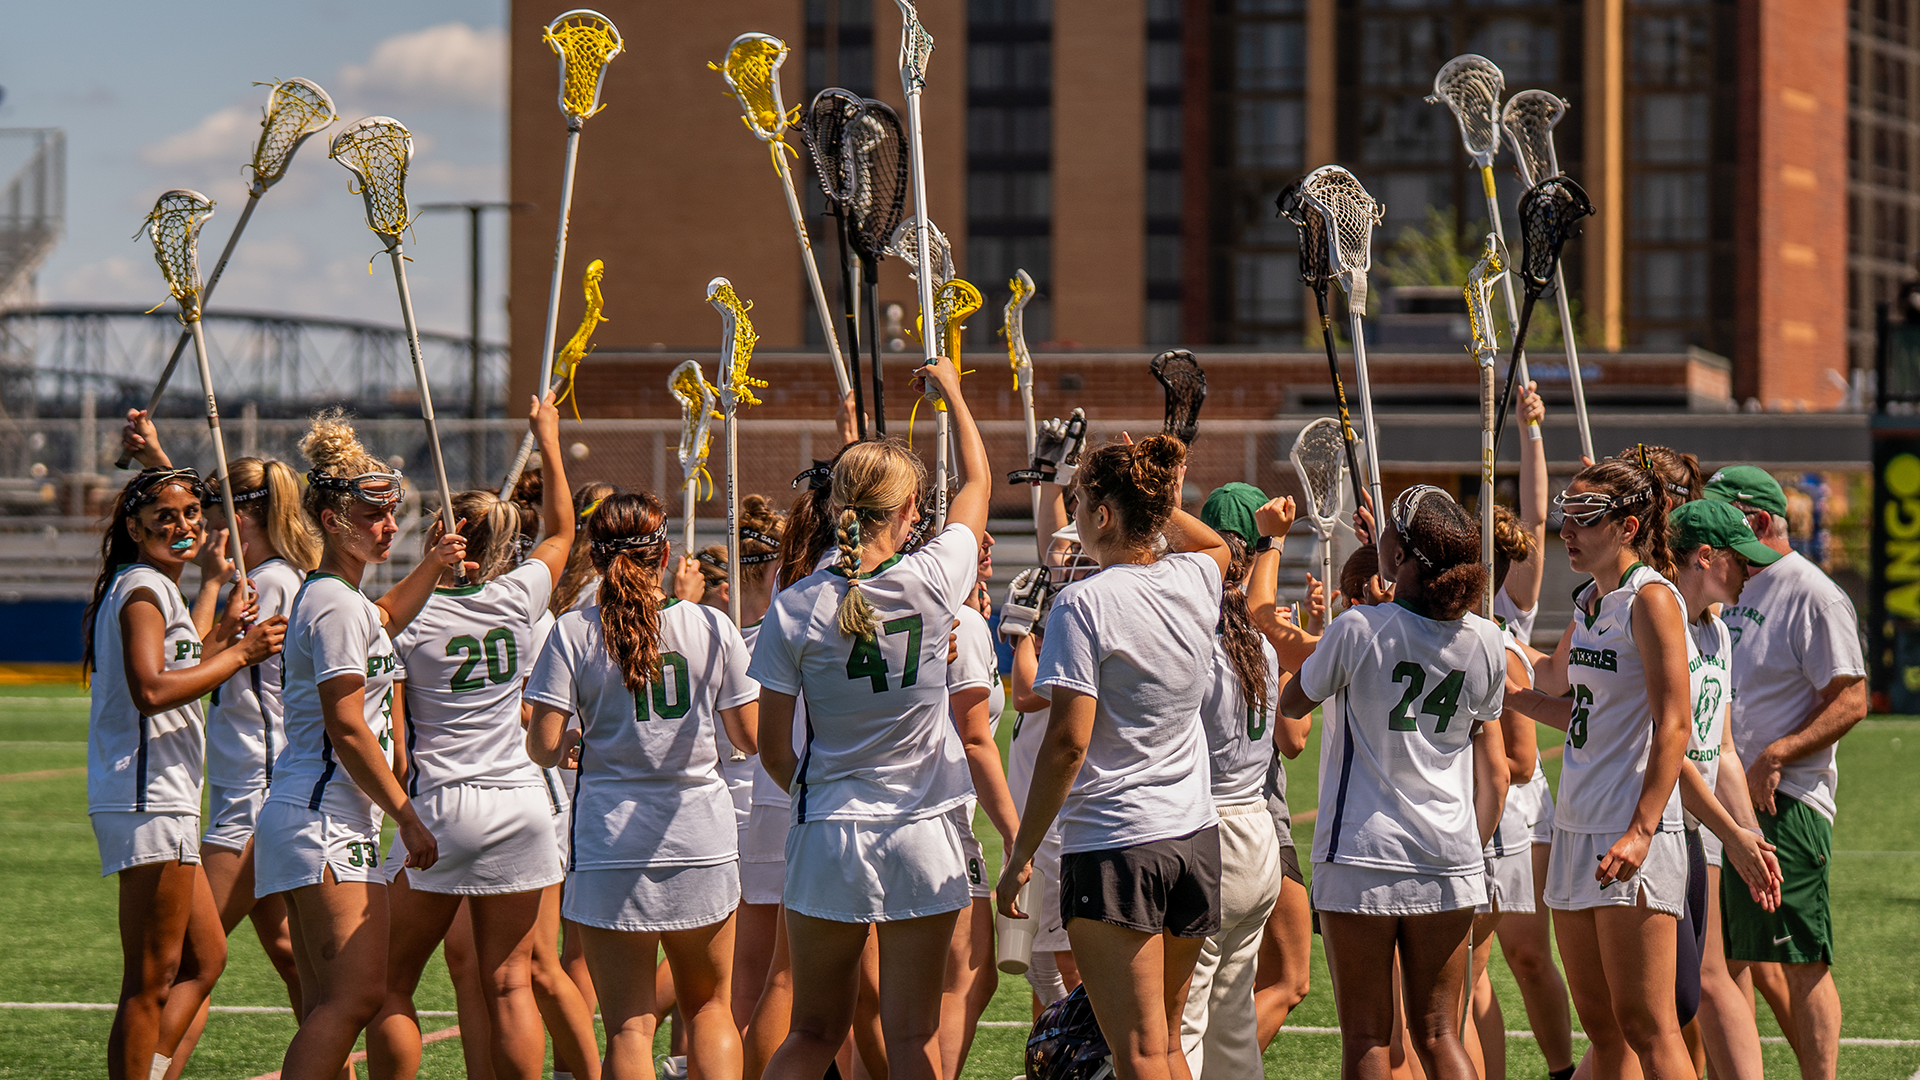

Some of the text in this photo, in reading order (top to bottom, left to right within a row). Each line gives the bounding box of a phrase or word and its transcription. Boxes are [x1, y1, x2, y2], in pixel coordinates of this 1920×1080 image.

[208, 394, 216, 414] GAI
[1336, 380, 1346, 404] ARIA
[1338, 407, 1353, 441] STX
[1483, 447, 1493, 486] STX
[233, 494, 248, 502] AIT
[250, 488, 269, 499] GAIT
[727, 474, 735, 536] MAVERIK
[760, 534, 780, 547] GAIT
[1413, 547, 1434, 568] STX
[174, 639, 203, 661] PI
[445, 626, 517, 692] 20
[846, 613, 923, 693] 47
[633, 651, 691, 722] 10
[1388, 661, 1466, 733] 24
[347, 841, 378, 868] 33
[969, 858, 981, 884] 9
